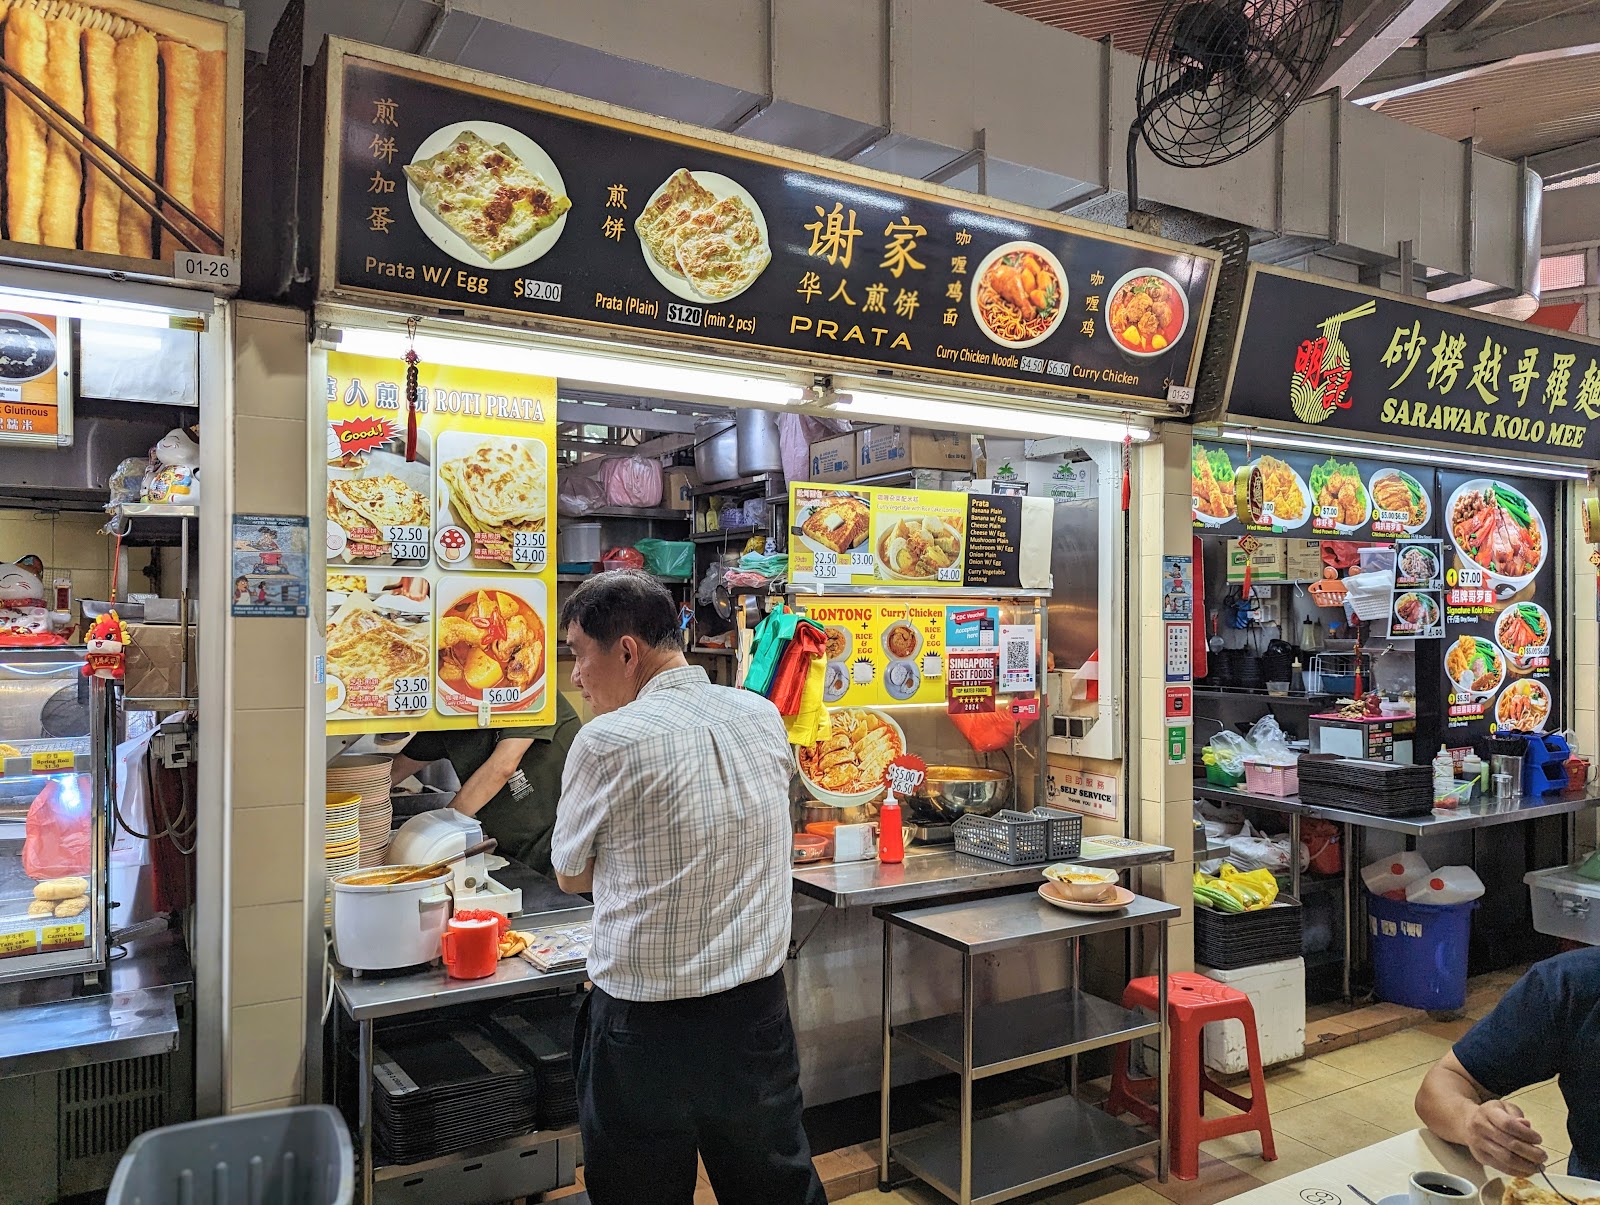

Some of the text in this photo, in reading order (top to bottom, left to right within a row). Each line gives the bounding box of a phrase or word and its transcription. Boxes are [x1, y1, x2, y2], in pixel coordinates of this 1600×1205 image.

[366, 98, 399, 233] 煎饼加蛋
[602, 184, 629, 241] 煎饼
[804, 202, 927, 278] 谢家
[186, 258, 229, 278] 01-26
[365, 257, 415, 280] Prata
[423, 266, 450, 286] W/
[457, 271, 489, 294] Egg
[526, 281, 559, 300] $2.00
[943, 229, 972, 327] 咖喱鸡面
[797, 271, 920, 320] 华人煎饼
[1081, 270, 1104, 338] 咖喱鸡
[595, 293, 756, 335] Prata (Plain) $1.20 (min 2 pcs)
[790, 315, 912, 351] PRATA
[937, 345, 958, 362] Curry
[960, 348, 990, 366] Chicken
[991, 352, 1018, 369] Noodle
[1073, 365, 1139, 385] Curry Chicken
[1172, 389, 1189, 400] 01-25
[4, 405, 49, 417] Glutinous
[435, 389, 481, 415] ROTI
[486, 394, 545, 422] PRATA
[1380, 398, 1586, 449] SARAWAK KOLO MEE
[340, 424, 384, 442] Good!
[972, 499, 990, 507] Prata
[1323, 507, 1338, 516] $7.00
[390, 527, 422, 541] $2.50
[515, 531, 545, 546] $3.50
[394, 543, 426, 558] $3.00
[515, 548, 544, 562] $4.00
[814, 552, 873, 566] $2.50 $3.00
[814, 565, 837, 577] $3.50
[940, 569, 960, 580] $4.00
[1461, 571, 1481, 583] $7.00
[1452, 590, 1493, 603] 招牌哥罗面
[811, 608, 873, 622] LONTONG
[881, 608, 943, 619] Curry Chicken
[1447, 606, 1470, 616] Signature
[950, 658, 994, 669] SINGAPORE
[950, 670, 992, 679] BEST FOODS
[395, 678, 427, 693] $3.50
[489, 688, 519, 702] $6.00
[1457, 694, 1470, 702] $5.50
[394, 695, 427, 711] $4.00
[895, 768, 915, 783] $5.00
[892, 780, 913, 795] $6.50
[1060, 785, 1112, 803] SELF SERVICE
